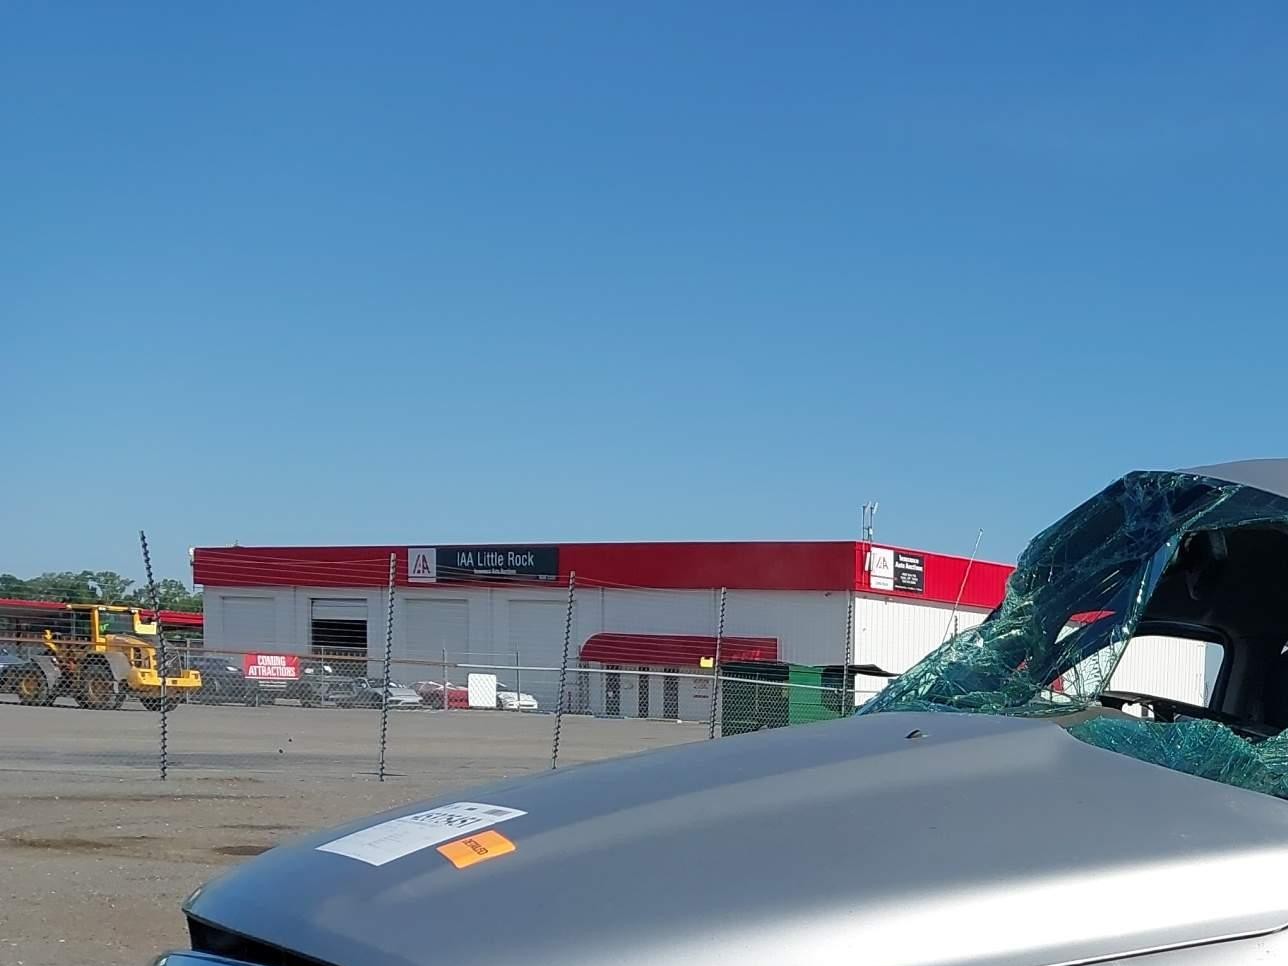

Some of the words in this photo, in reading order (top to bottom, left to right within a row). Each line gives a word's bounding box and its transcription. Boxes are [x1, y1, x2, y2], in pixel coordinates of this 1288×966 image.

[457, 551, 474, 567] IAA
[477, 551, 504, 567] Little
[507, 551, 535, 567] Rock
[257, 655, 286, 667] COMING
[248, 665, 296, 677] ATTRACTIONS
